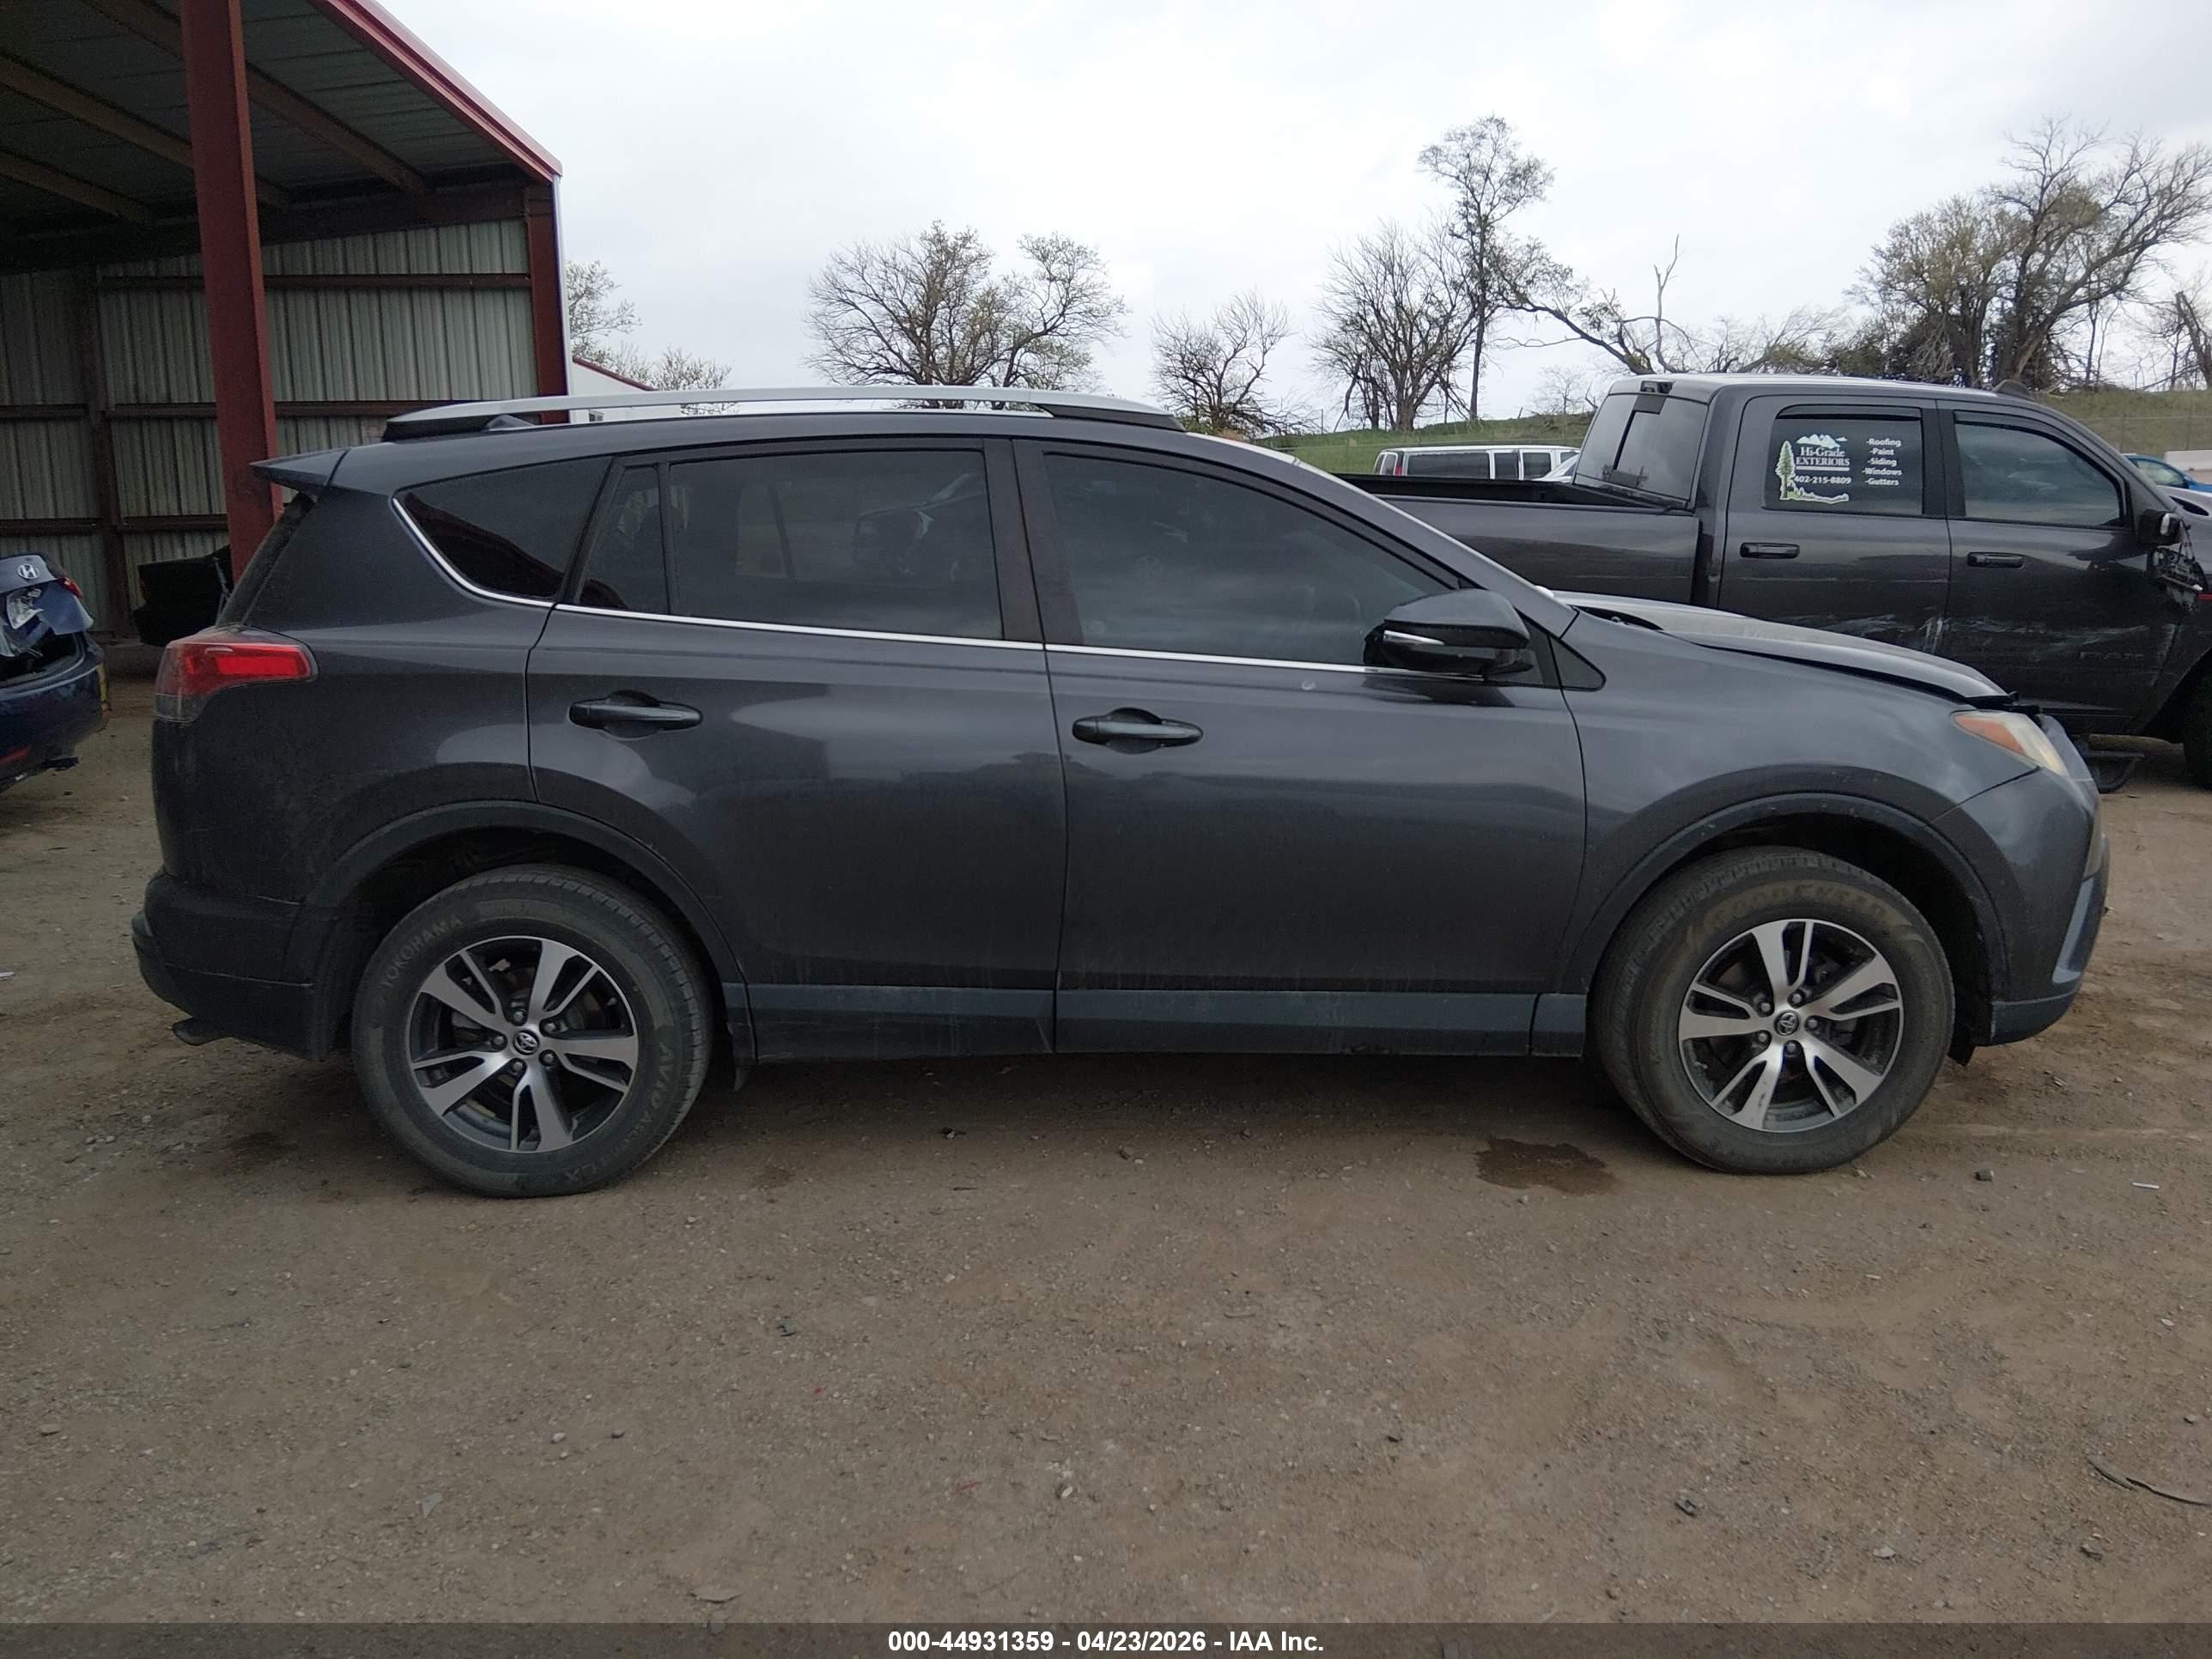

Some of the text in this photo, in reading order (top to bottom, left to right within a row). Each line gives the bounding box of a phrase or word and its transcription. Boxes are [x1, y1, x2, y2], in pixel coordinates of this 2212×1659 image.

[1800, 447, 1845, 457] Hi-Grade
[1796, 456, 1850, 466] EXTERIORS
[378, 915, 463, 988] YOKOHAMA
